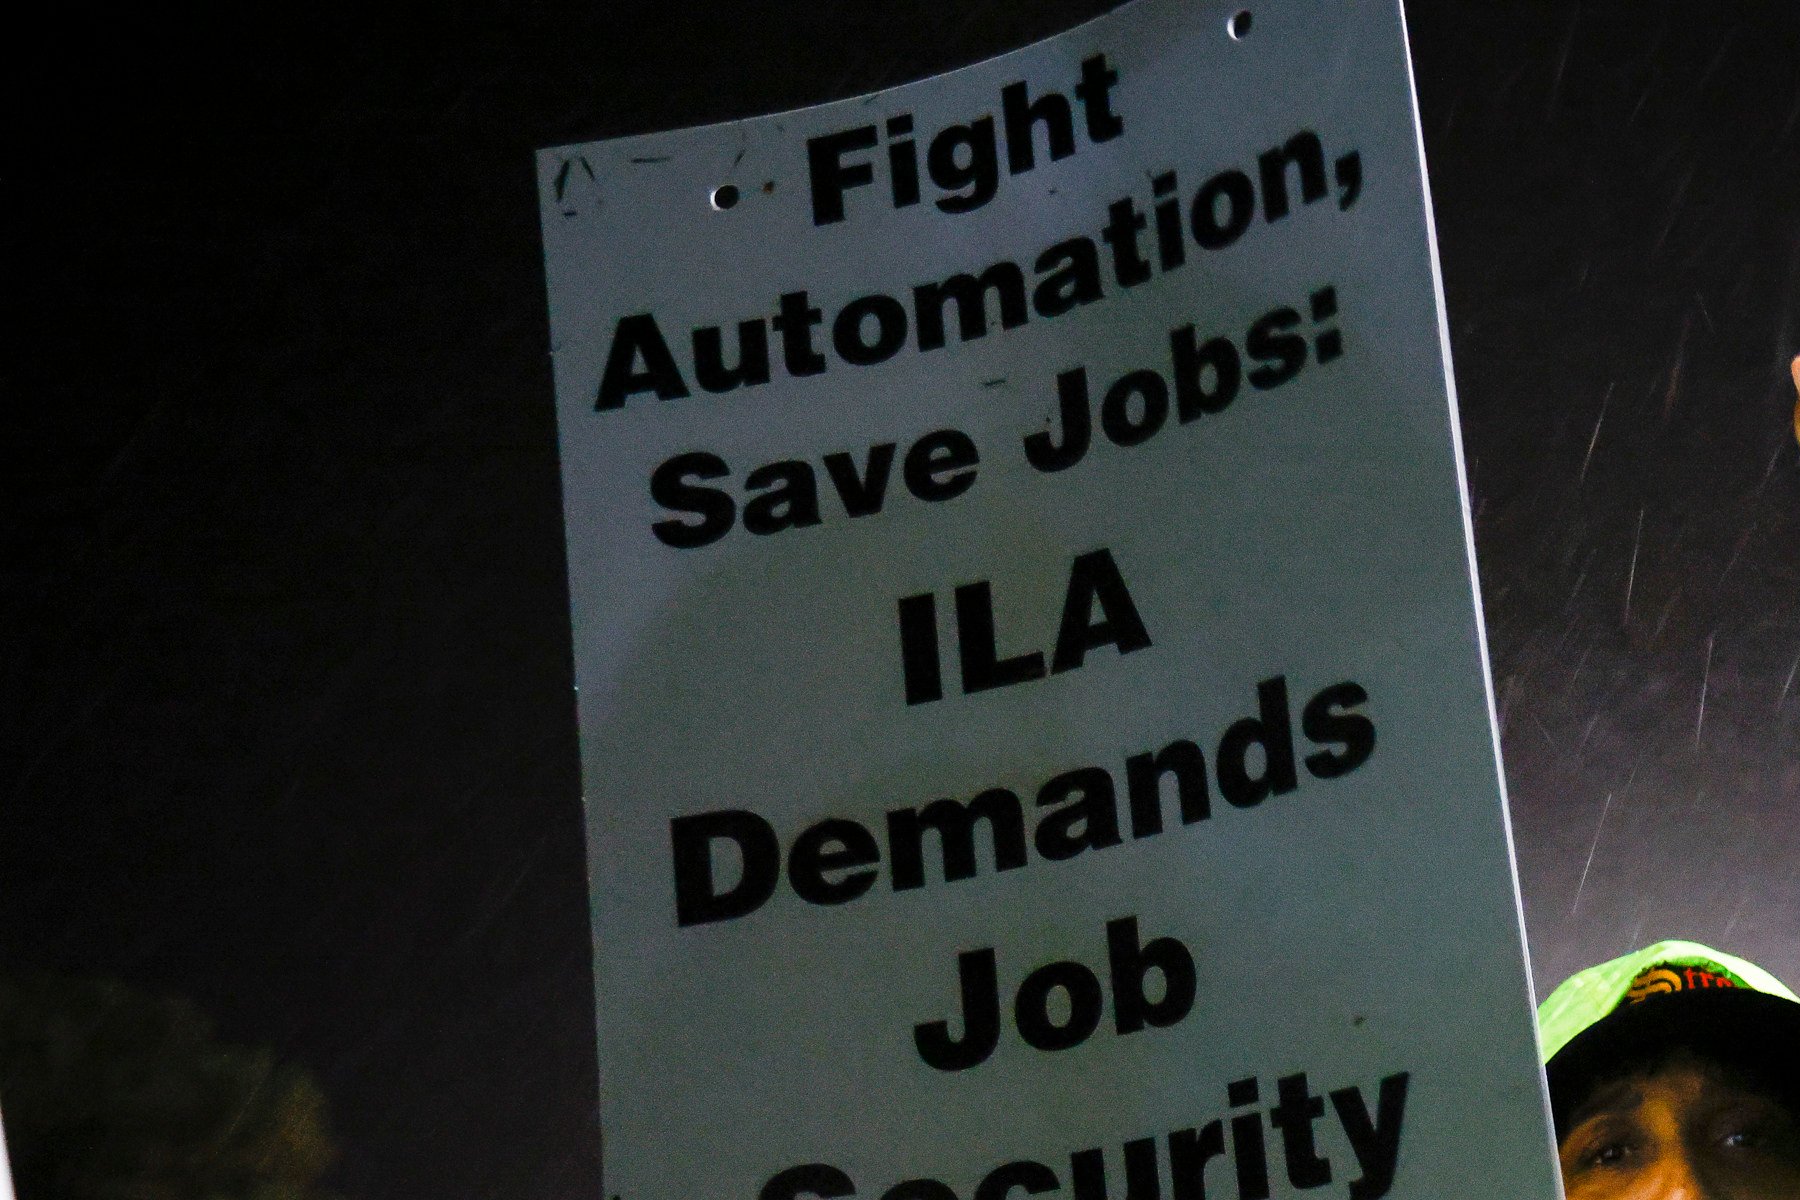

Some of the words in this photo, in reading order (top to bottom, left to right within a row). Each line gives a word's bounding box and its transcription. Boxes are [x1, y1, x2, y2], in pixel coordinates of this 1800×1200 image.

[806, 50, 1125, 228] Fight
[593, 129, 1364, 413] Automation,
[649, 428, 980, 551] Save
[1022, 284, 1344, 474] Jobs:
[897, 546, 1153, 707] ILA
[669, 674, 1377, 929] Demands
[912, 914, 1198, 1073] Job
